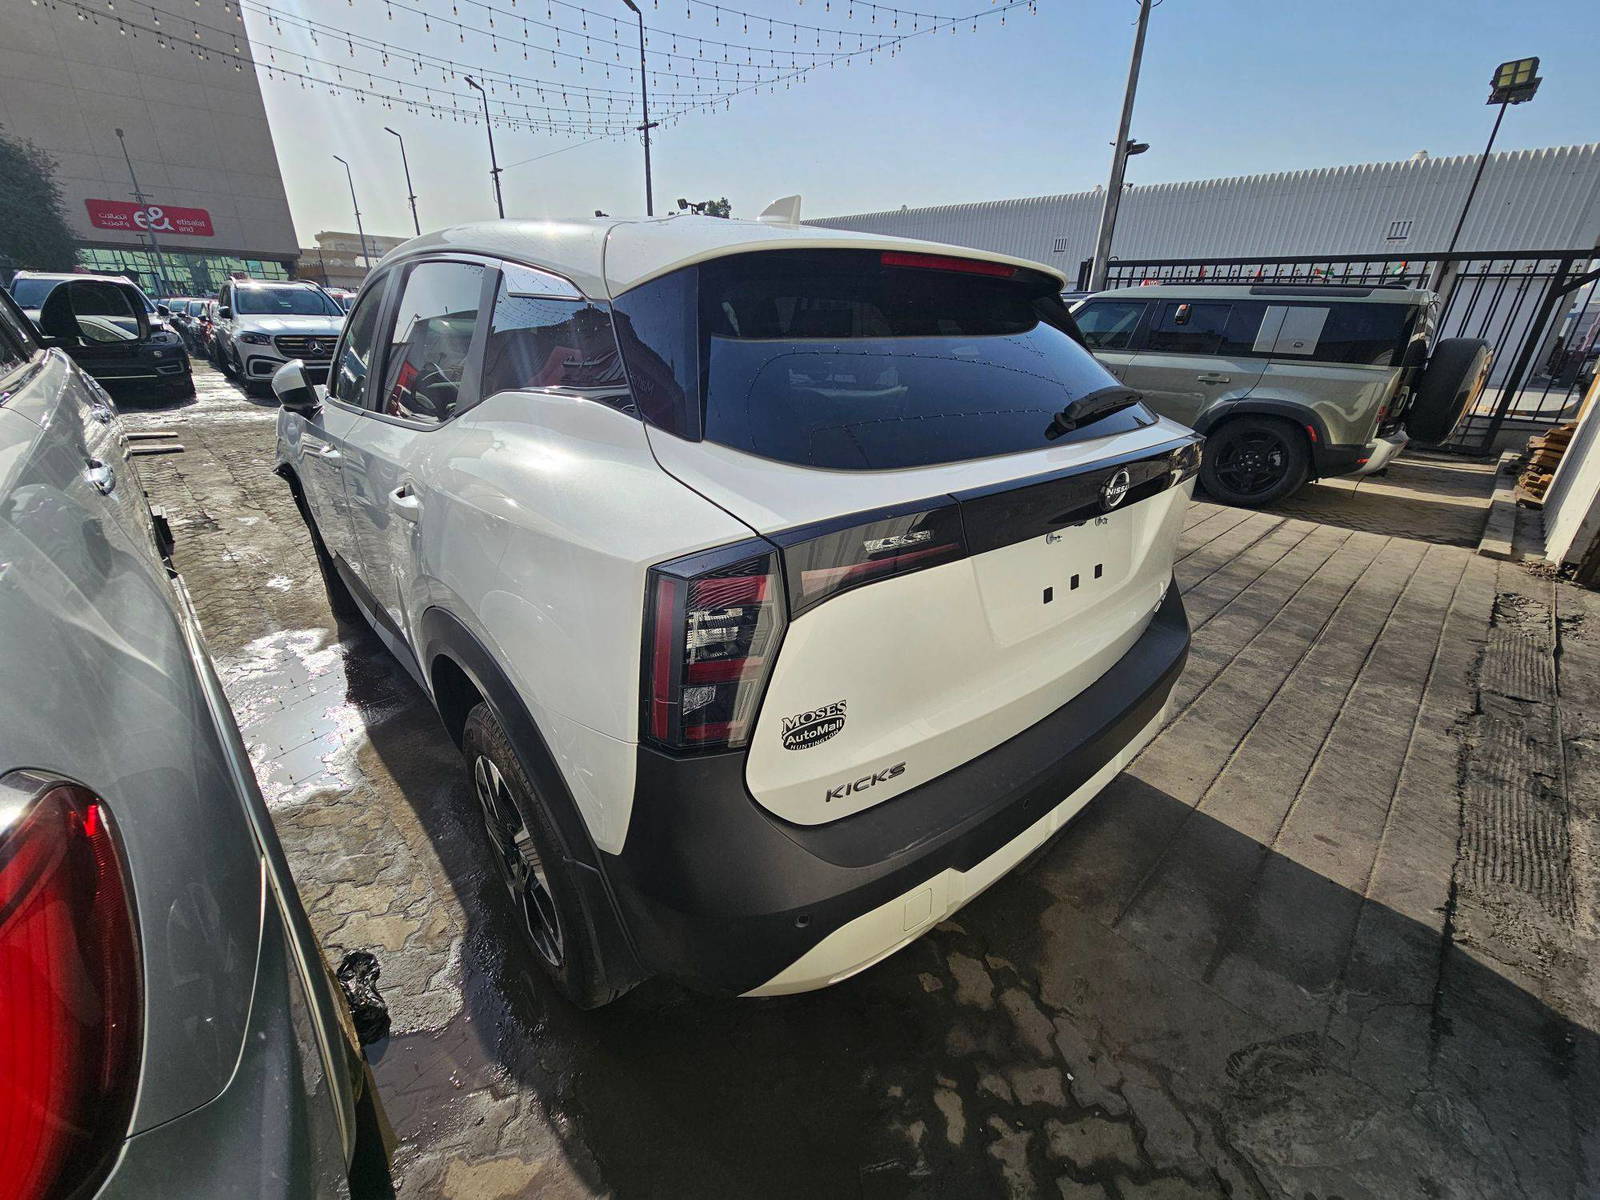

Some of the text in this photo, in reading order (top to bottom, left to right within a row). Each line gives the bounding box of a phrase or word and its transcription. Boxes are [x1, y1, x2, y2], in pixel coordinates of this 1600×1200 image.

[176, 218, 205, 227] etisalat
[178, 225, 194, 233] and
[782, 700, 847, 734] MOSES
[786, 719, 843, 746] AutoMall
[790, 729, 840, 750] HUNTINGTON
[825, 761, 906, 803] KICKS
